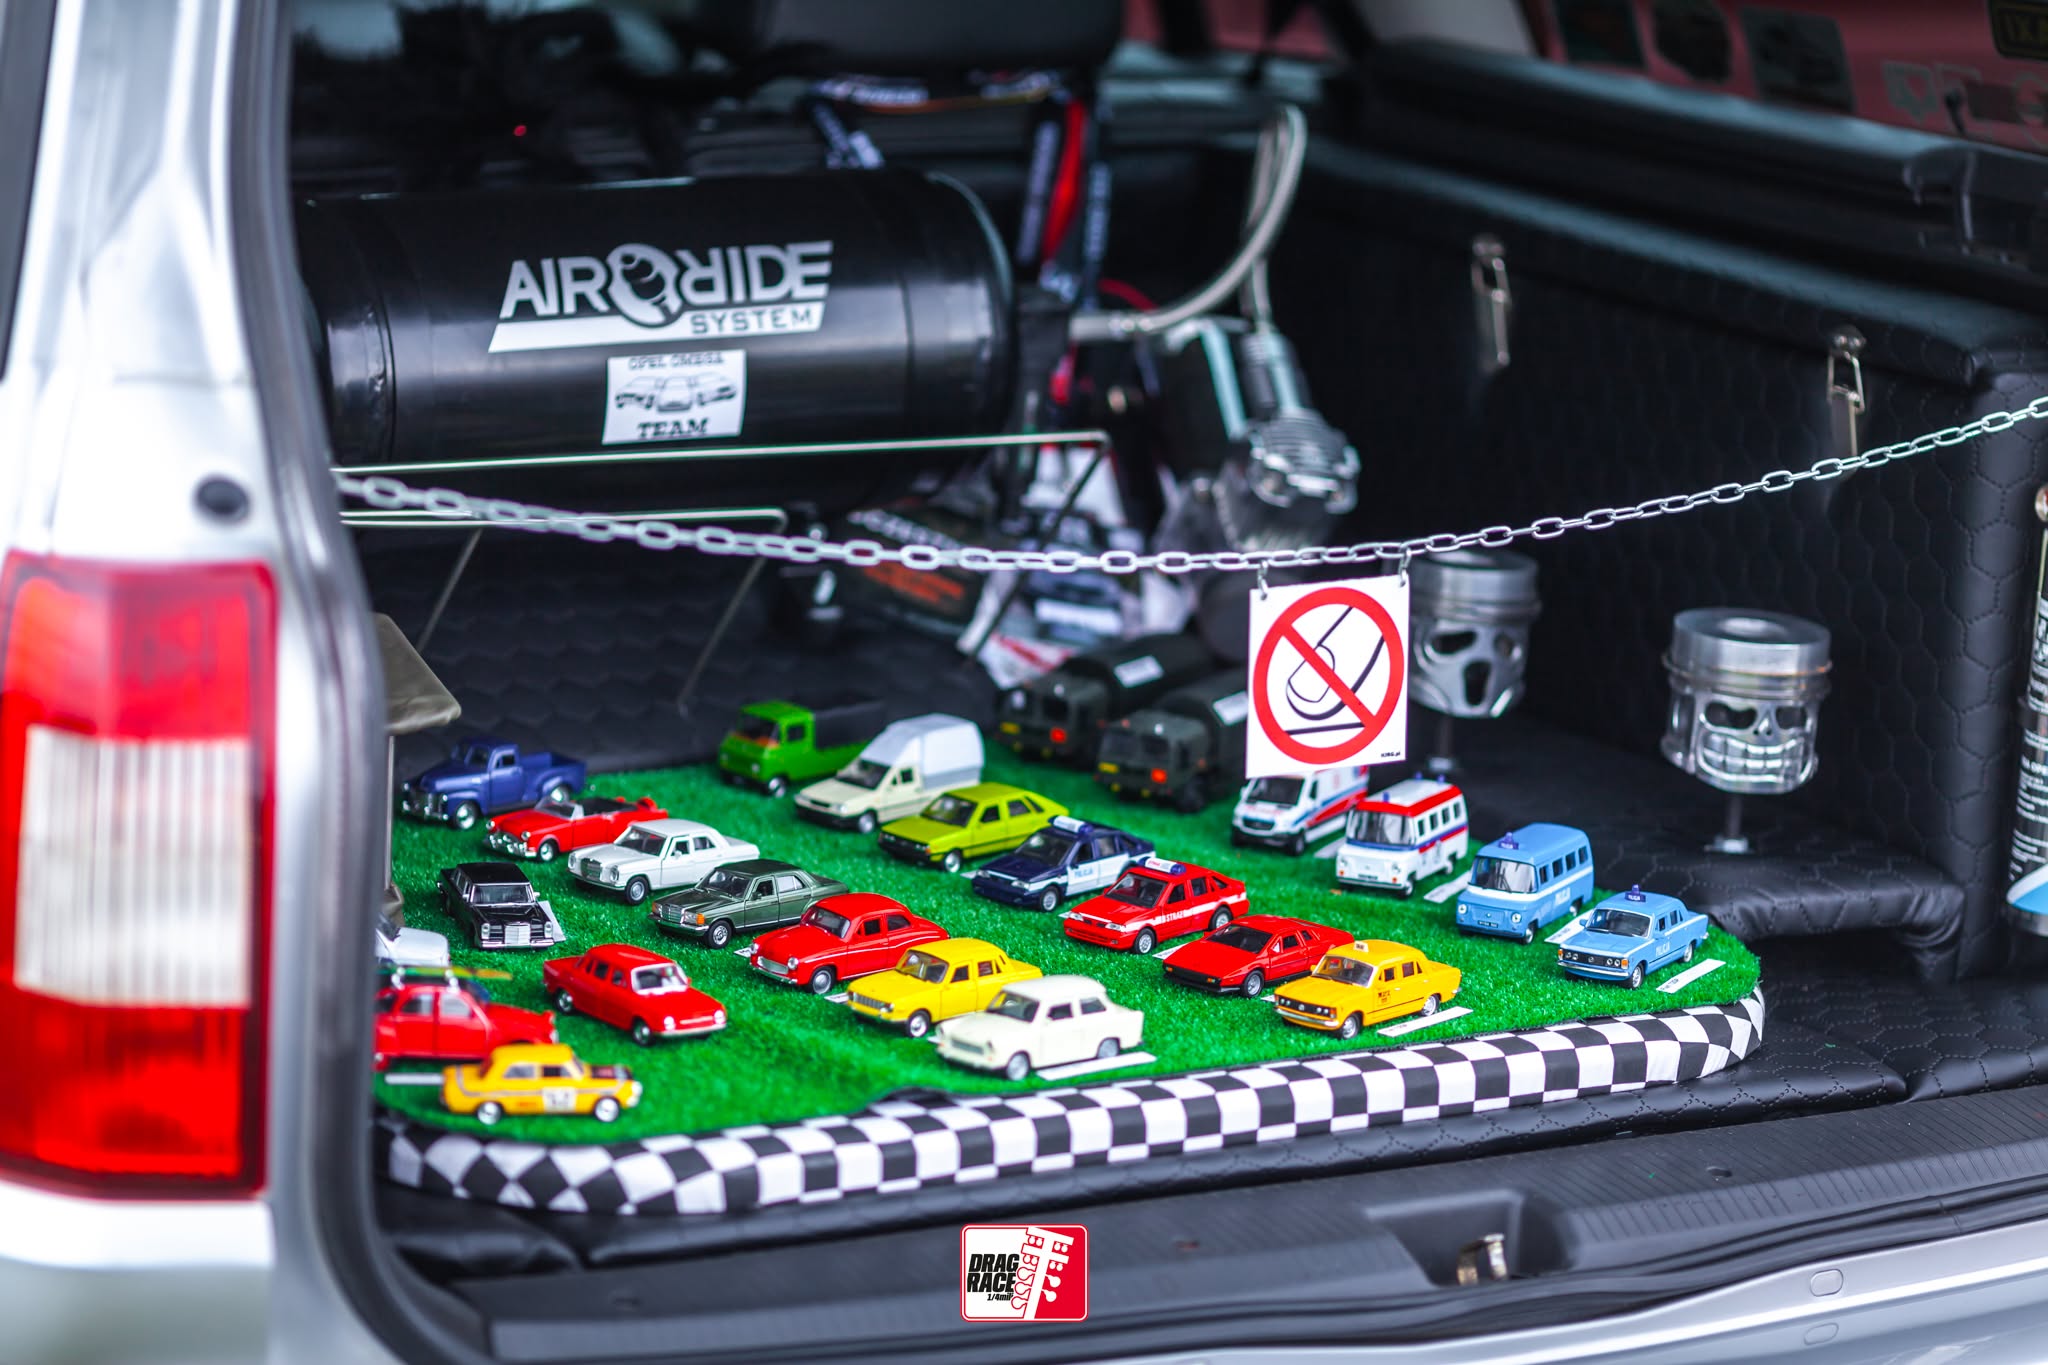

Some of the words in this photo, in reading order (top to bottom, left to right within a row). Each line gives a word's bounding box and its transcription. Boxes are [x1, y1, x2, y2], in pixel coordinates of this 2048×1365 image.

[499, 256, 611, 319] AIR
[690, 309, 813, 335] SYSTEM
[628, 357, 667, 371] OPEL
[636, 417, 709, 438] TEAM
